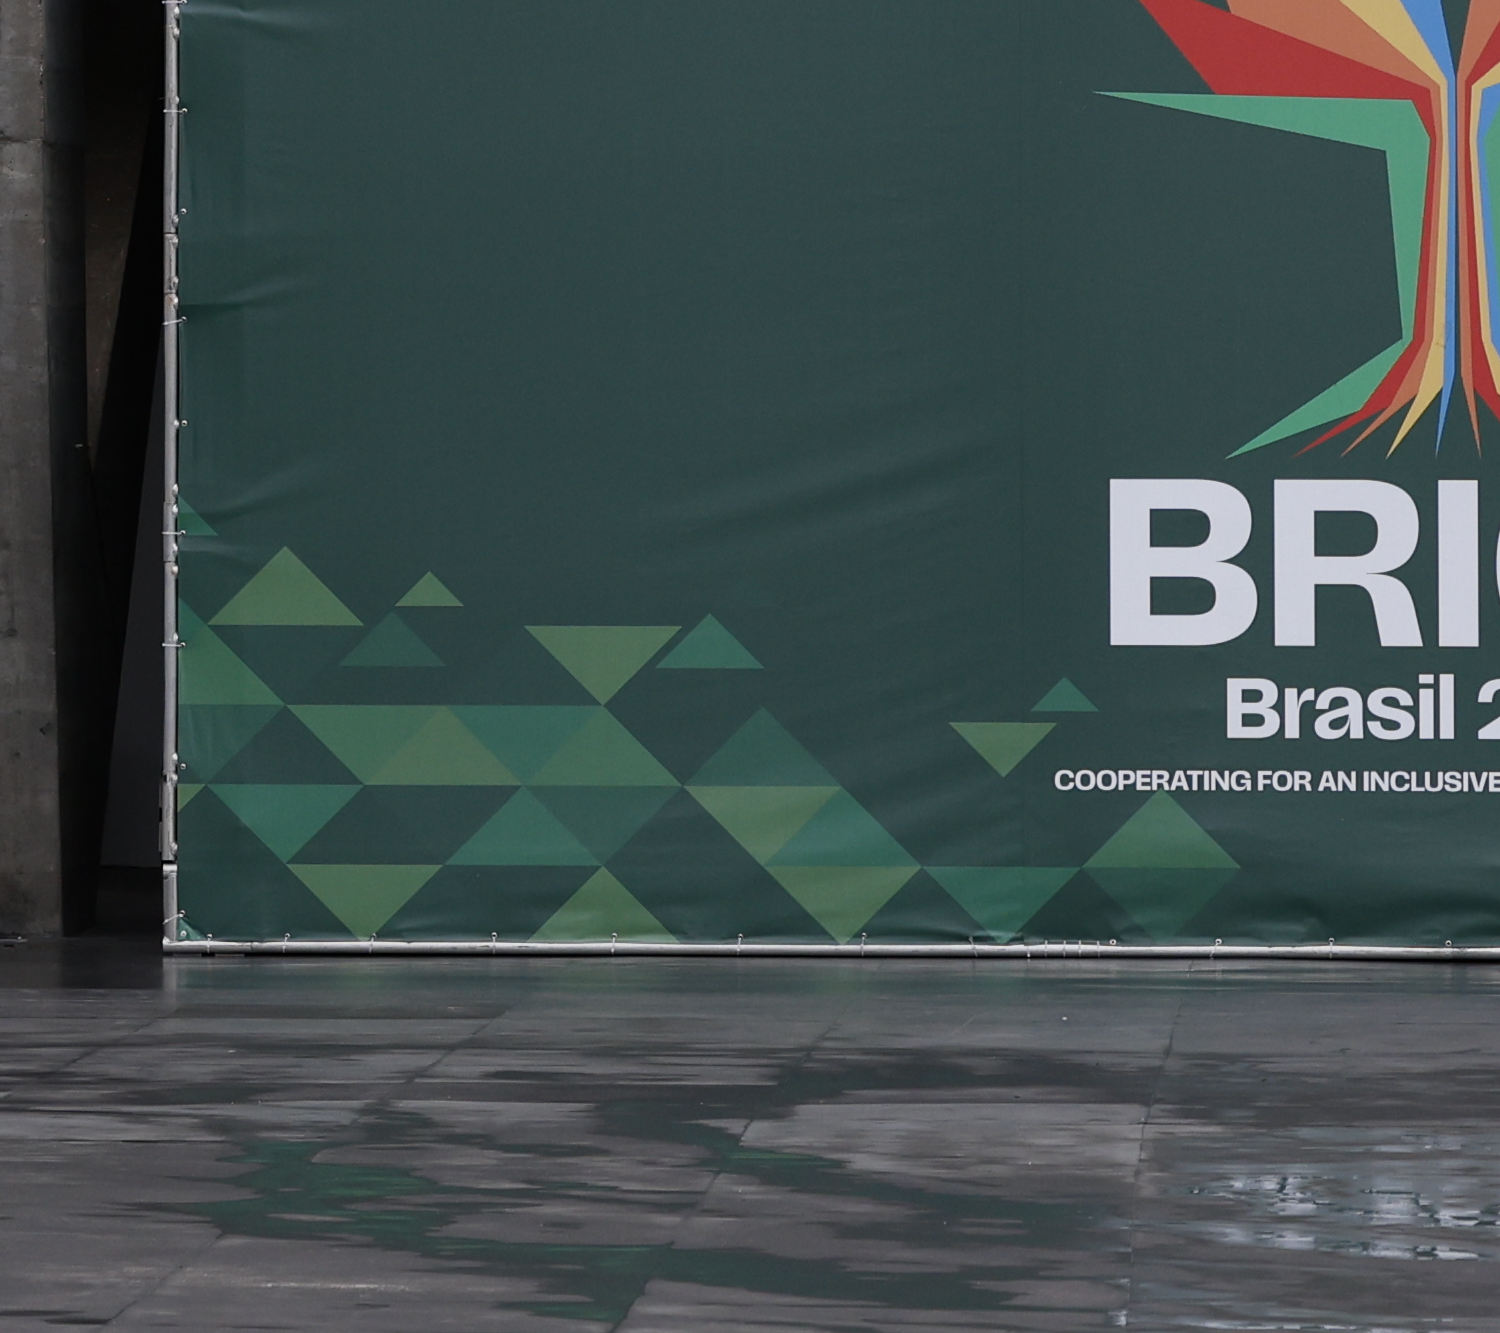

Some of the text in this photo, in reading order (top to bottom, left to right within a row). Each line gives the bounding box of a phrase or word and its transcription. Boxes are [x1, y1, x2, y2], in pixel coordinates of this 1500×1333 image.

[1225, 673, 1456, 741] Brasil
[1054, 769, 1252, 793] COOPERATING
[1257, 769, 1313, 792] FOR
[1317, 770, 1357, 792] AN
